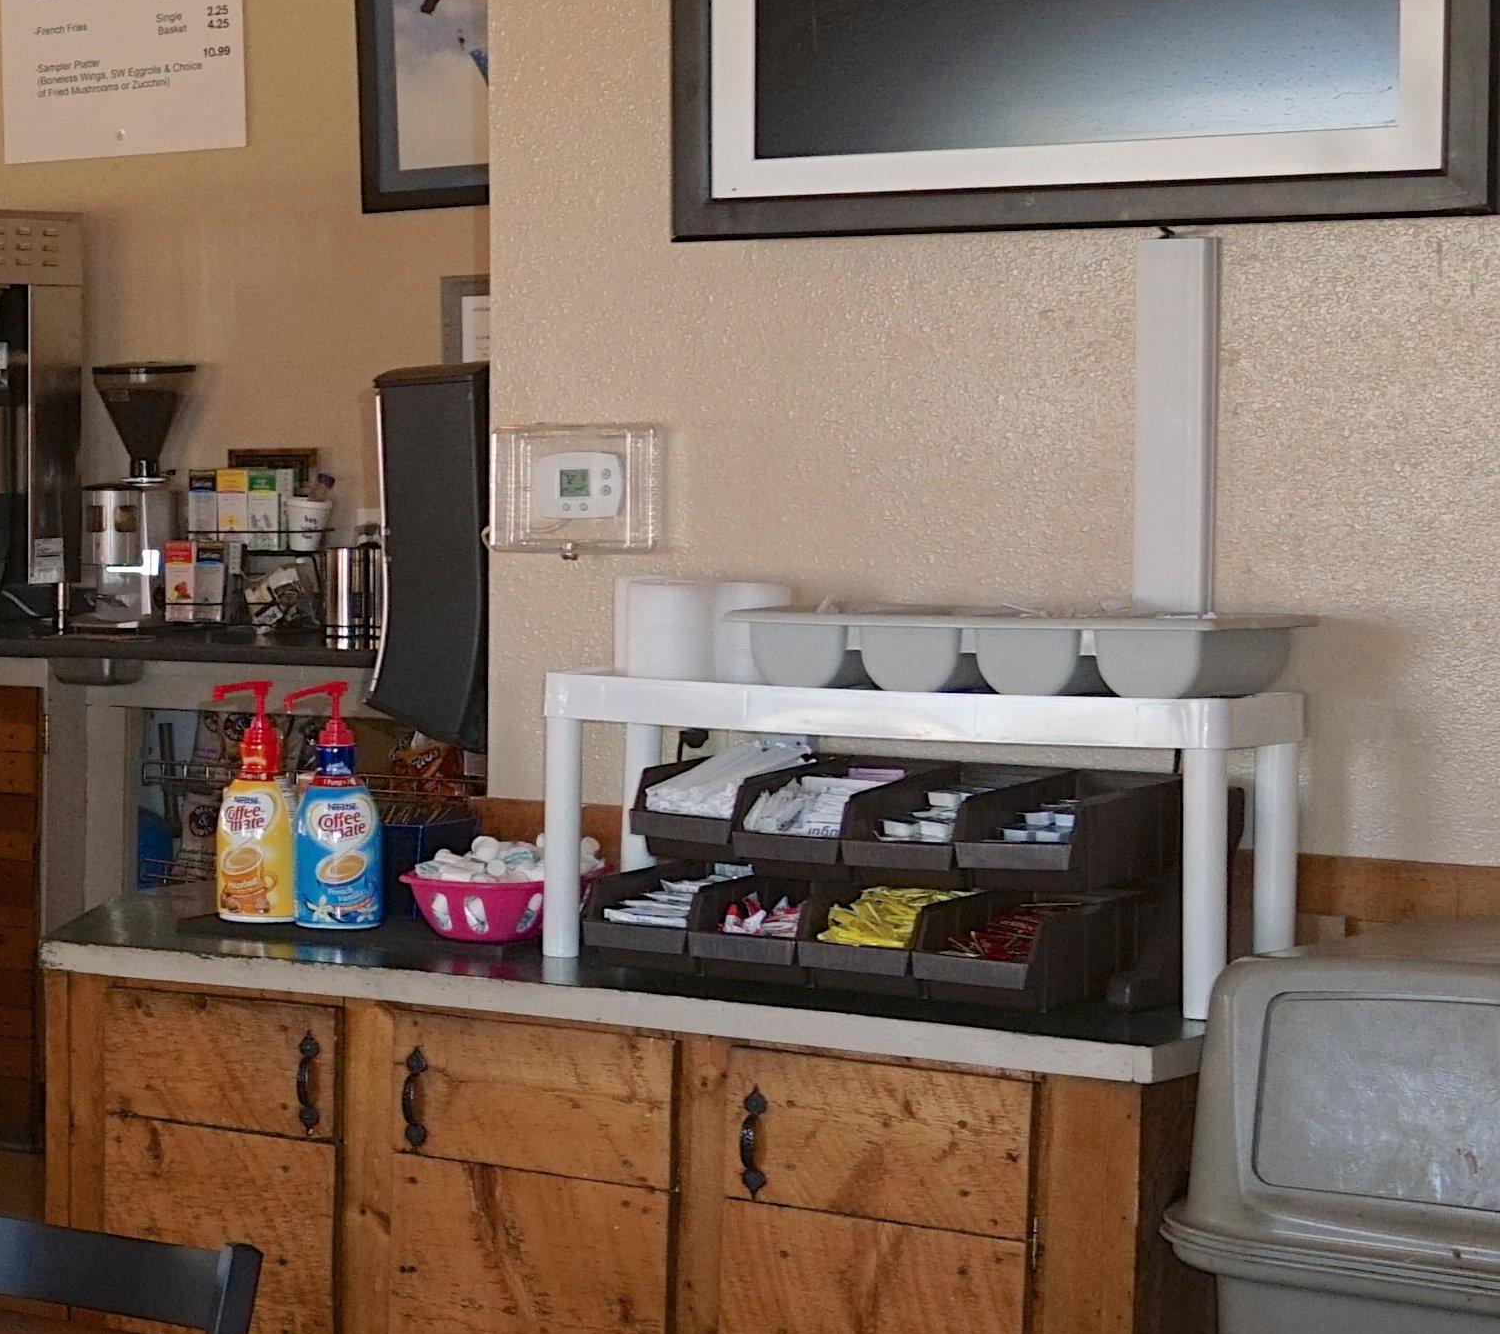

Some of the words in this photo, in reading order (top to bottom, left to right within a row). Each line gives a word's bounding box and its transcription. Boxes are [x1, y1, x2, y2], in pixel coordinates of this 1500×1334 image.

[155, 11, 182, 24] Single
[206, 4, 229, 16] 2.25
[157, 23, 187, 36] Basket
[206, 17, 230, 29] 4.25
[203, 45, 231, 57] 10.99
[110, 68, 126, 79] SW
[37, 88, 46, 98] of
[47, 86, 69, 96] Fried
[70, 83, 119, 95] Mushrooms
[120, 81, 130, 90] or
[318, 811, 361, 832] Coffee
